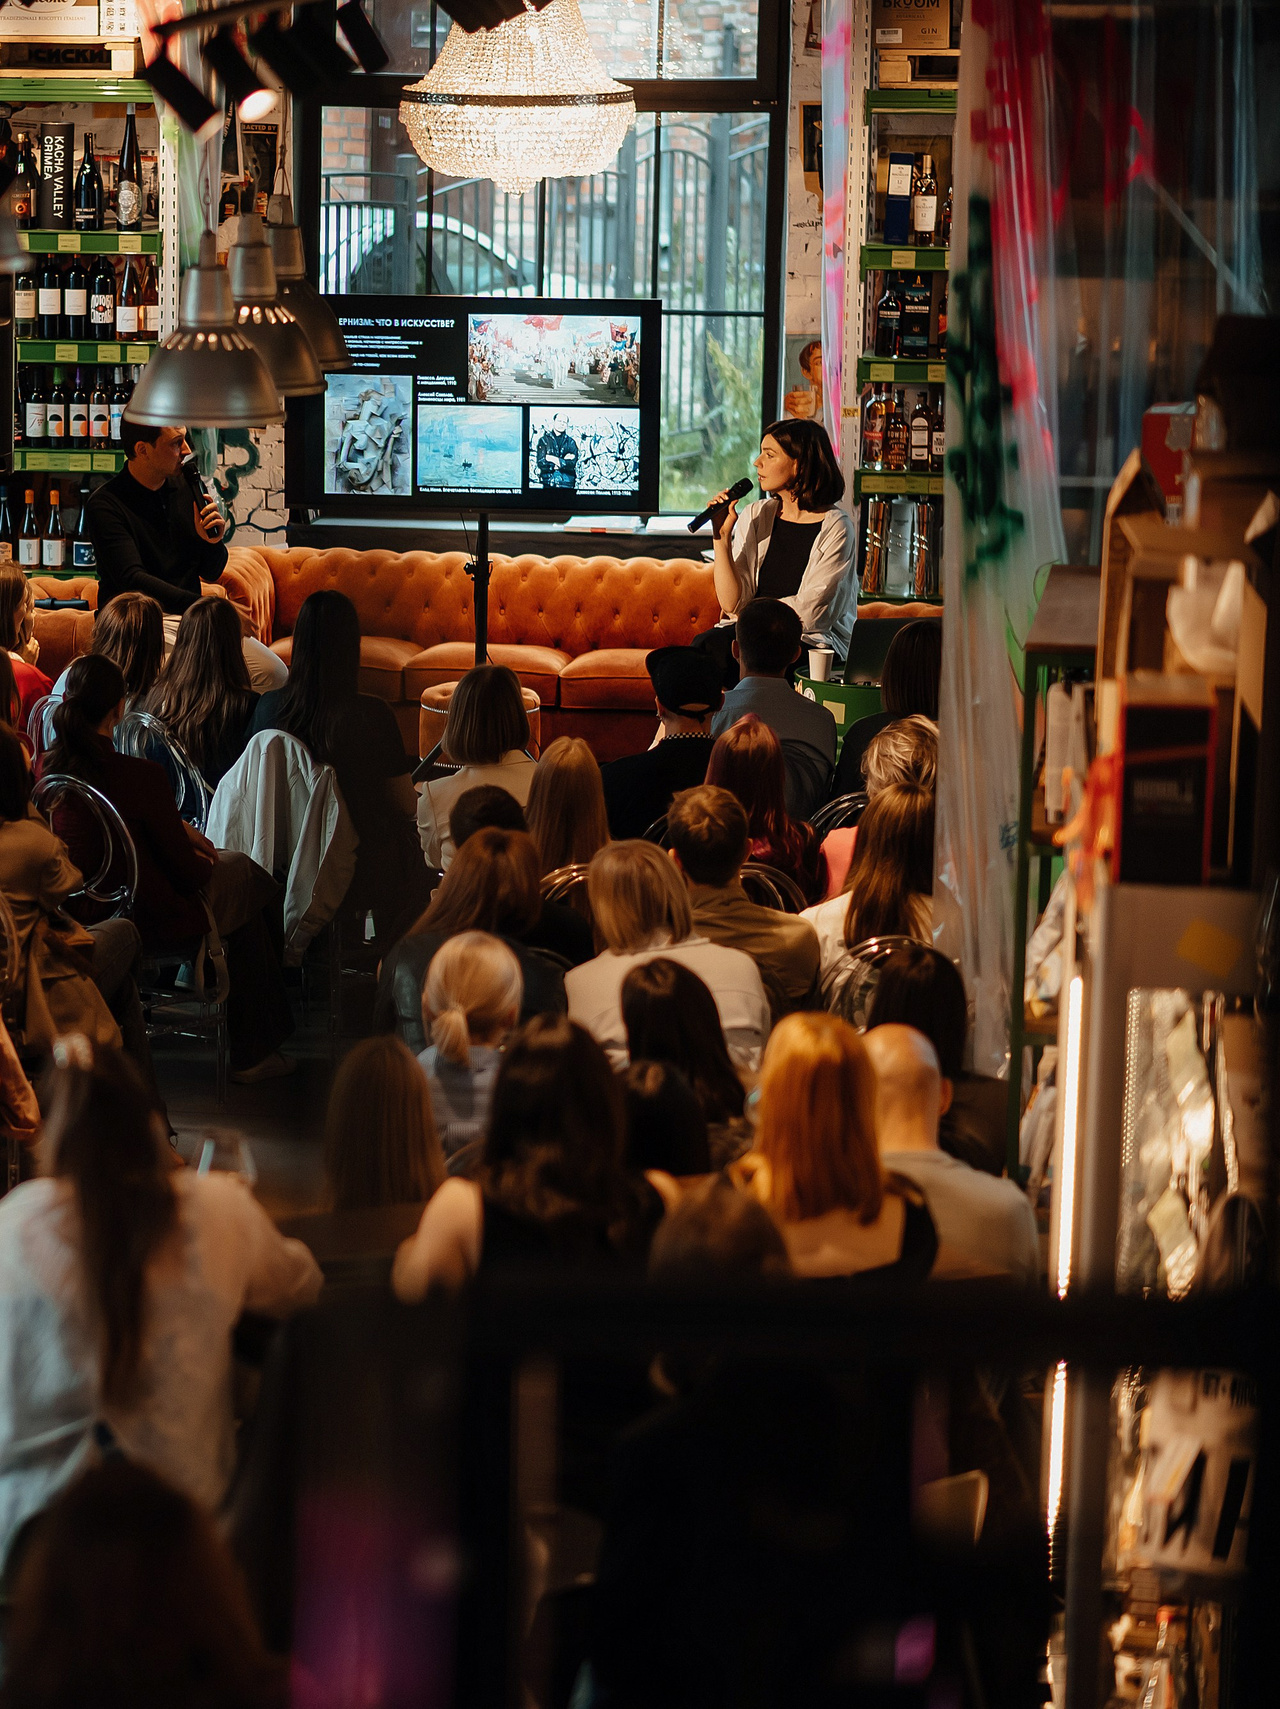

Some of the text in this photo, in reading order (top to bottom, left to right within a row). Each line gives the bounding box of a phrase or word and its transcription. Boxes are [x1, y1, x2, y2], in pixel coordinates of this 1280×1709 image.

[920, 27, 938, 35] GIN
[43, 135, 54, 181] CRIMEA
[52, 135, 65, 219] KACHA VALLEY
[375, 318, 393, 327] ЧТО
[393, 318, 400, 327] В
[400, 319, 455, 328] ИСКУССТВЕ?
